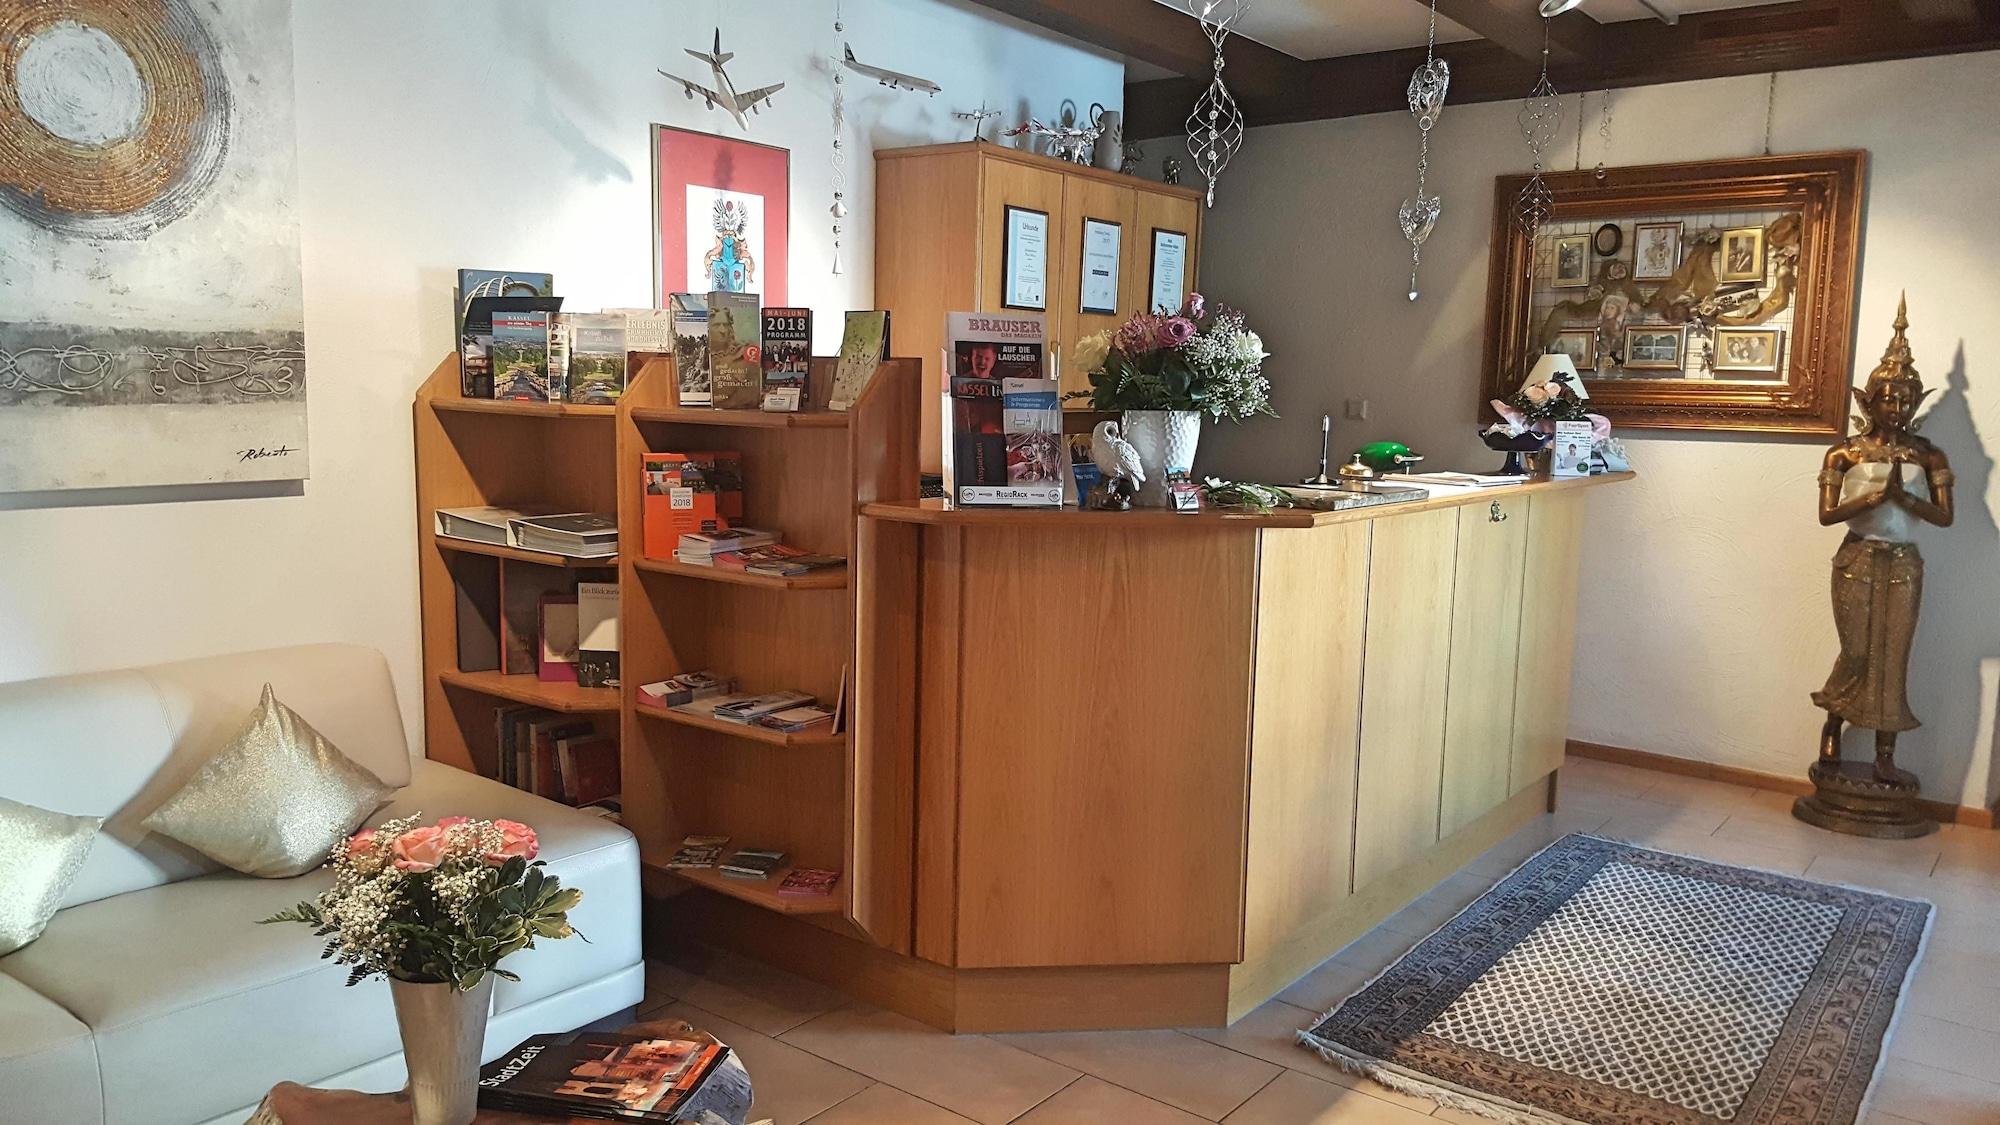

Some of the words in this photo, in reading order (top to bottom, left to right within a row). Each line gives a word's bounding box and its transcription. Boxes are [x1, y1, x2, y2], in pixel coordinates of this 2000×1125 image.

[626, 319, 667, 330] ERLEBNIS
[767, 317, 806, 331] 2018
[968, 319, 1041, 333] BRAUSER
[766, 331, 806, 339] PROGRAMM
[1002, 345, 1017, 354] AUF
[1018, 346, 1031, 354] DIE
[997, 353, 1036, 362] LAUSCHER
[956, 383, 990, 396] KASSEL
[479, 1046, 545, 1087] StadtZeit
